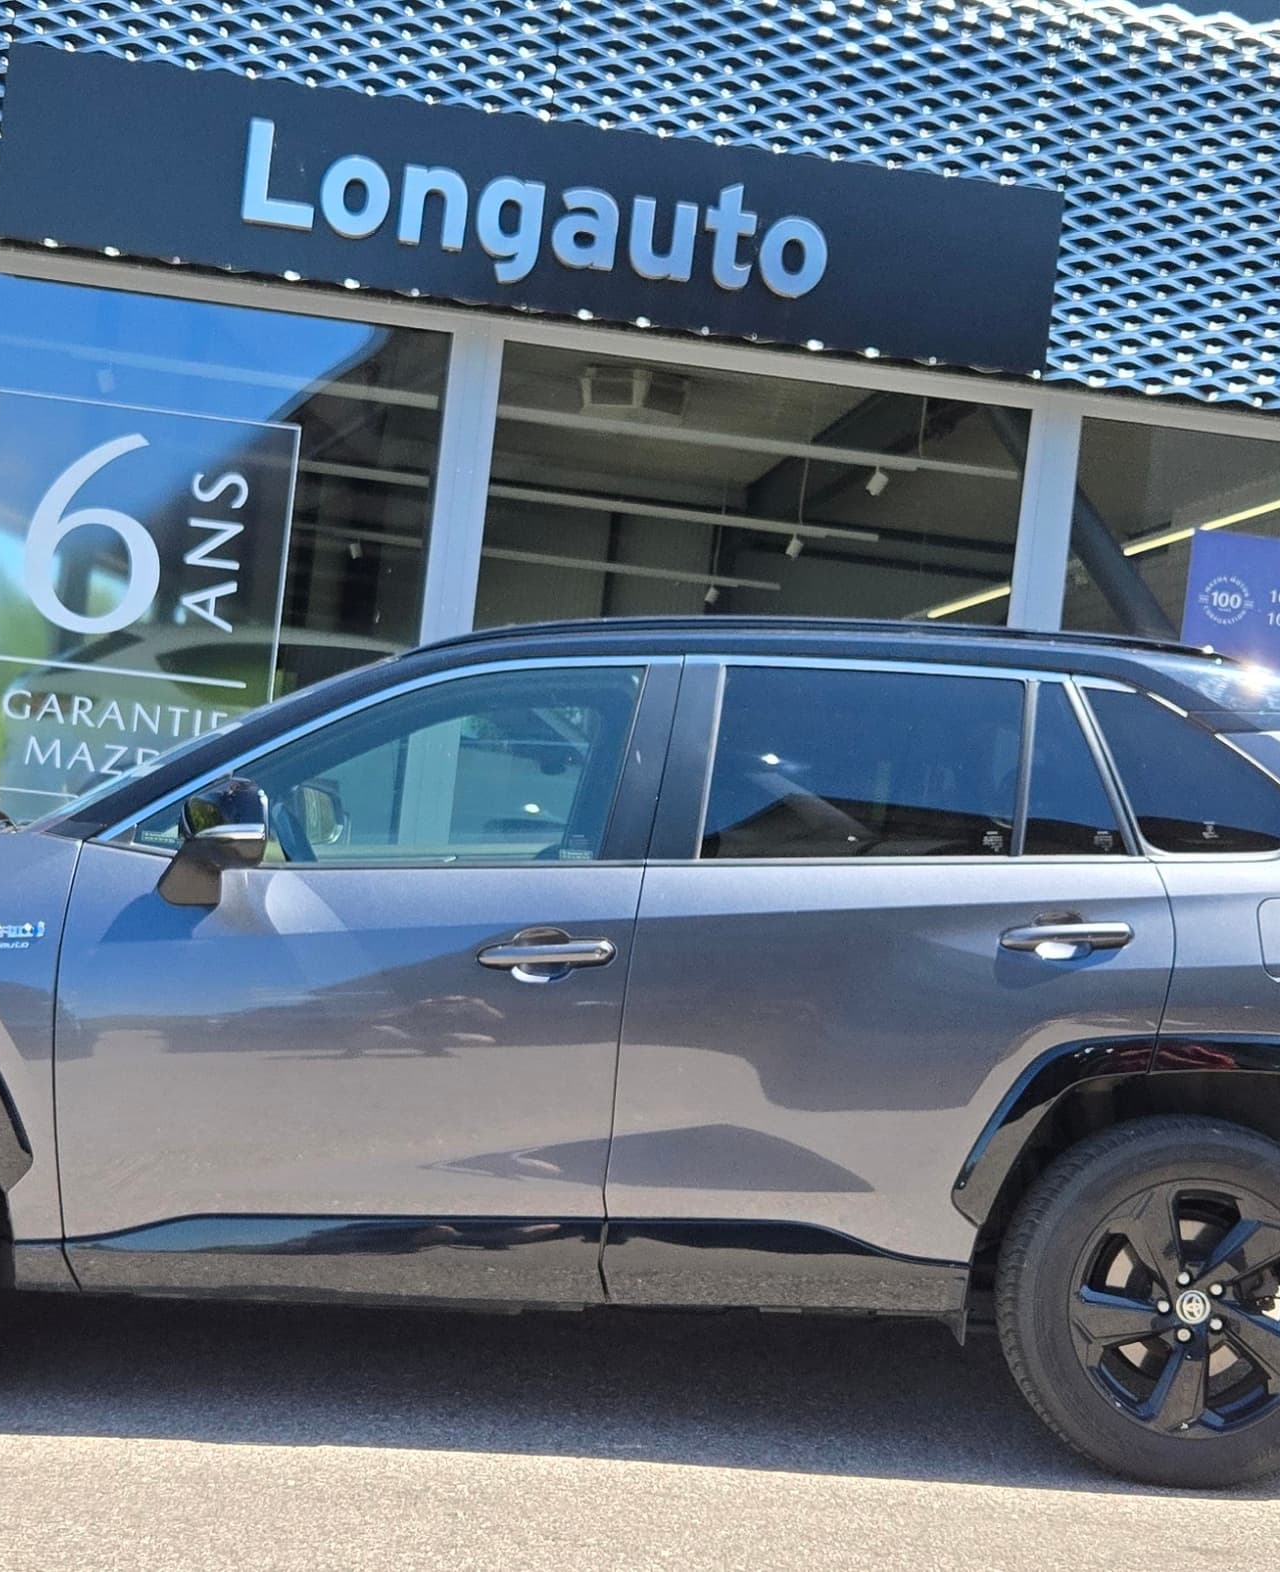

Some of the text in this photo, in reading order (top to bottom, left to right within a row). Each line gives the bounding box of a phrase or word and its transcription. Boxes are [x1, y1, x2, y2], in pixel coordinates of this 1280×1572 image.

[241, 117, 828, 298] Longauto
[27, 433, 160, 634] 6
[182, 472, 248, 632] ANS
[1211, 592, 1242, 609] 100
[24, 735, 160, 776] MAZ
